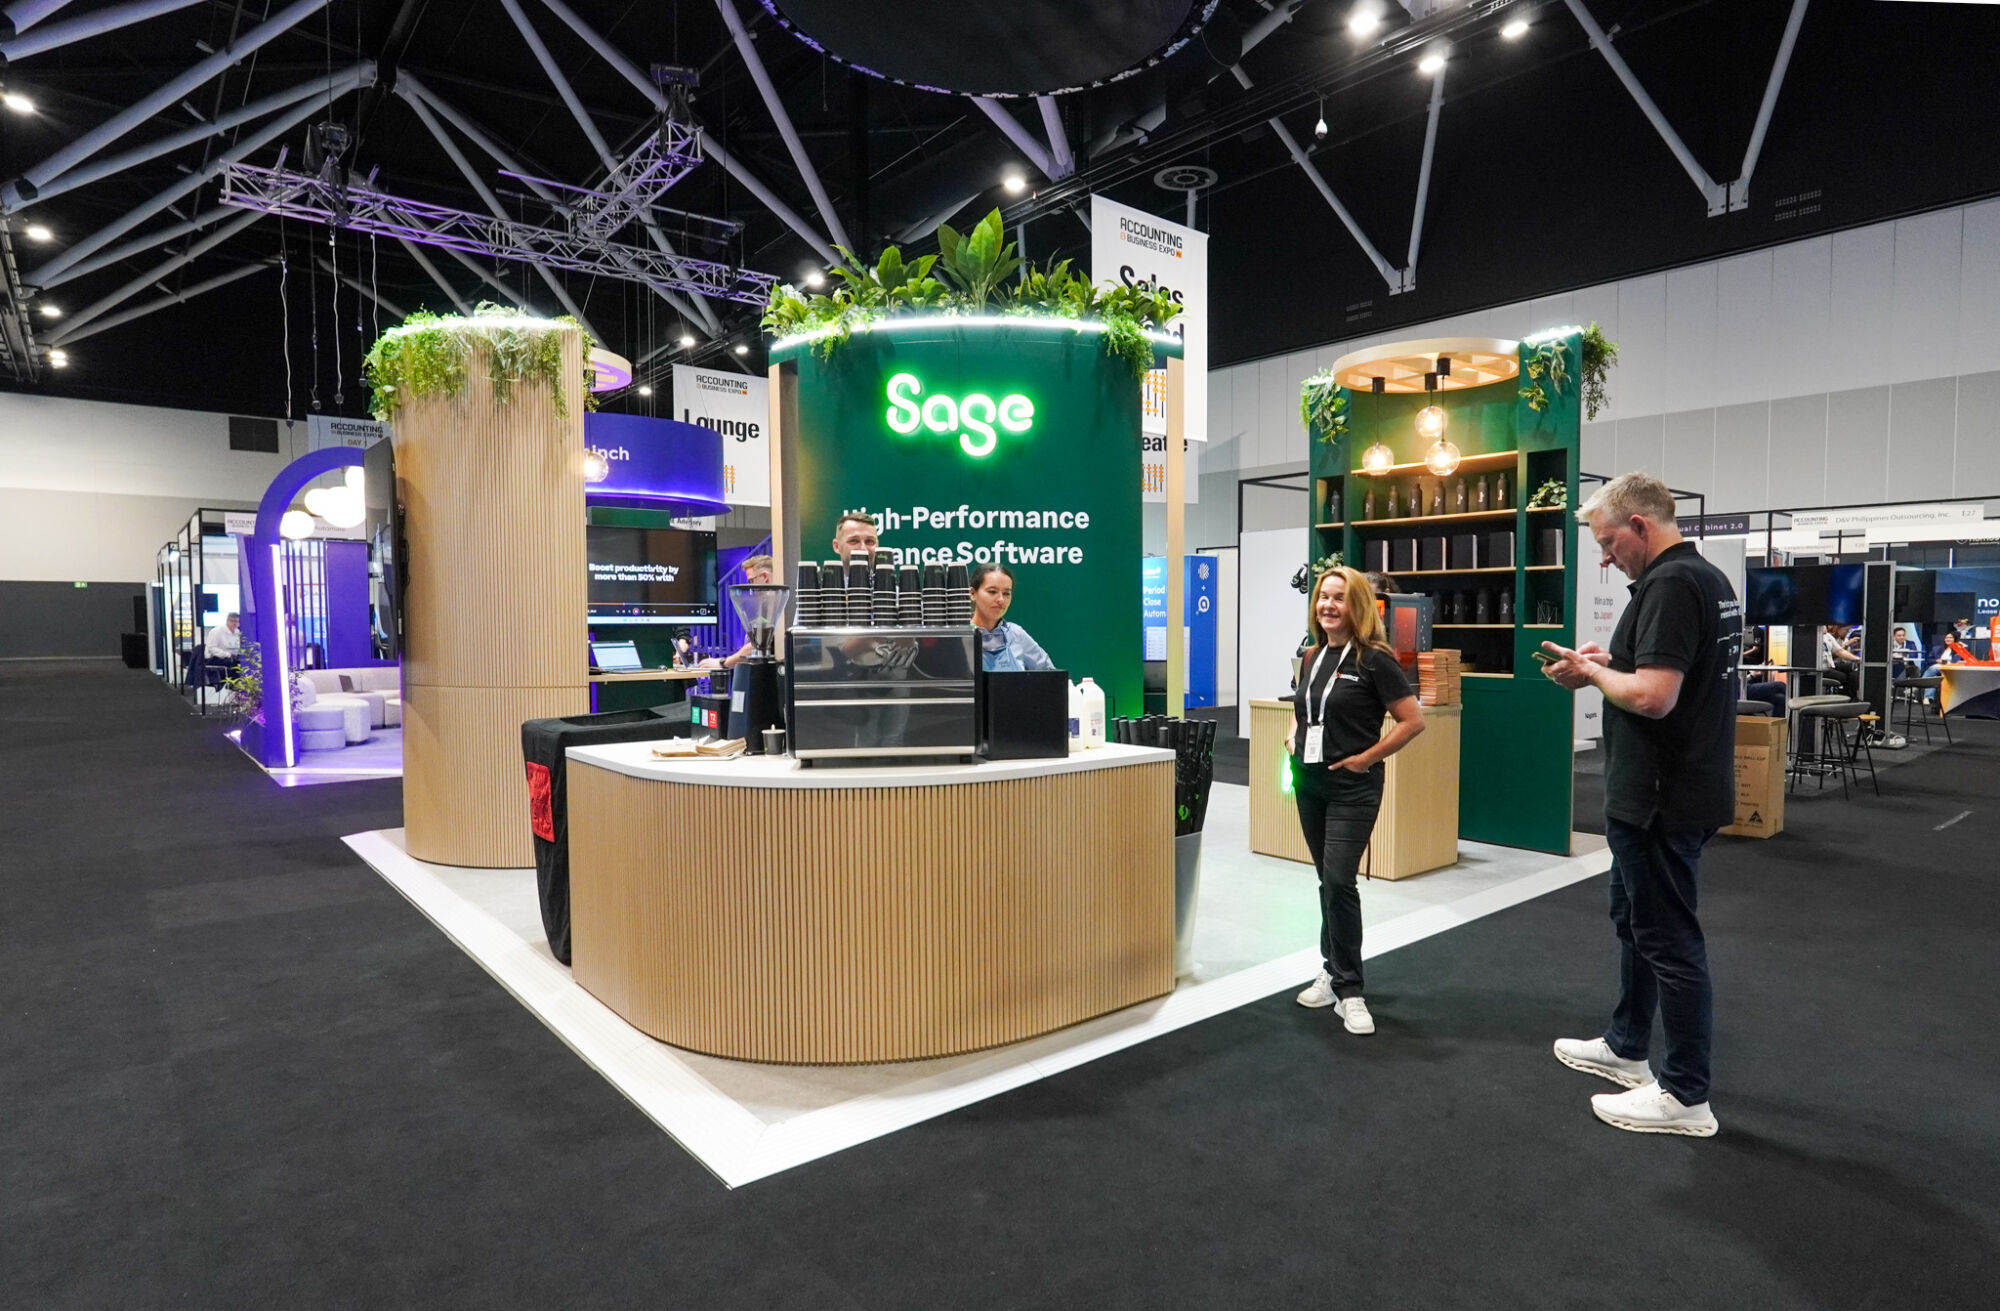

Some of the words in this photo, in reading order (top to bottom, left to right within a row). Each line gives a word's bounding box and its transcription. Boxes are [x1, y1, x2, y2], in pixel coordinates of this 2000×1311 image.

[1120, 217, 1183, 249] ACCOUNTING
[1126, 233, 1158, 251] BUSINESS
[1159, 244, 1176, 257] EXPO
[696, 374, 748, 390] ACCOUNTING
[701, 384, 727, 393] BUSINESS
[886, 373, 1035, 457] Sage
[330, 422, 383, 433] ACCOUNTING
[585, 444, 630, 461] inch
[843, 504, 1090, 536] gh-Performance
[1851, 514, 1890, 524] Philippines
[1694, 523, 1730, 532] Cbinet
[1730, 522, 1744, 530] 2.0
[956, 540, 1083, 565] Software
[588, 563, 614, 572] Boost
[615, 564, 668, 575] productivity
[668, 565, 680, 576] by
[594, 573, 617, 581] more
[618, 573, 637, 581] than
[638, 574, 655, 582] 50%
[655, 574, 675, 583] with
[1143, 584, 1166, 595] Period
[1143, 597, 1162, 607] Close
[1143, 609, 1167, 618] Autom
